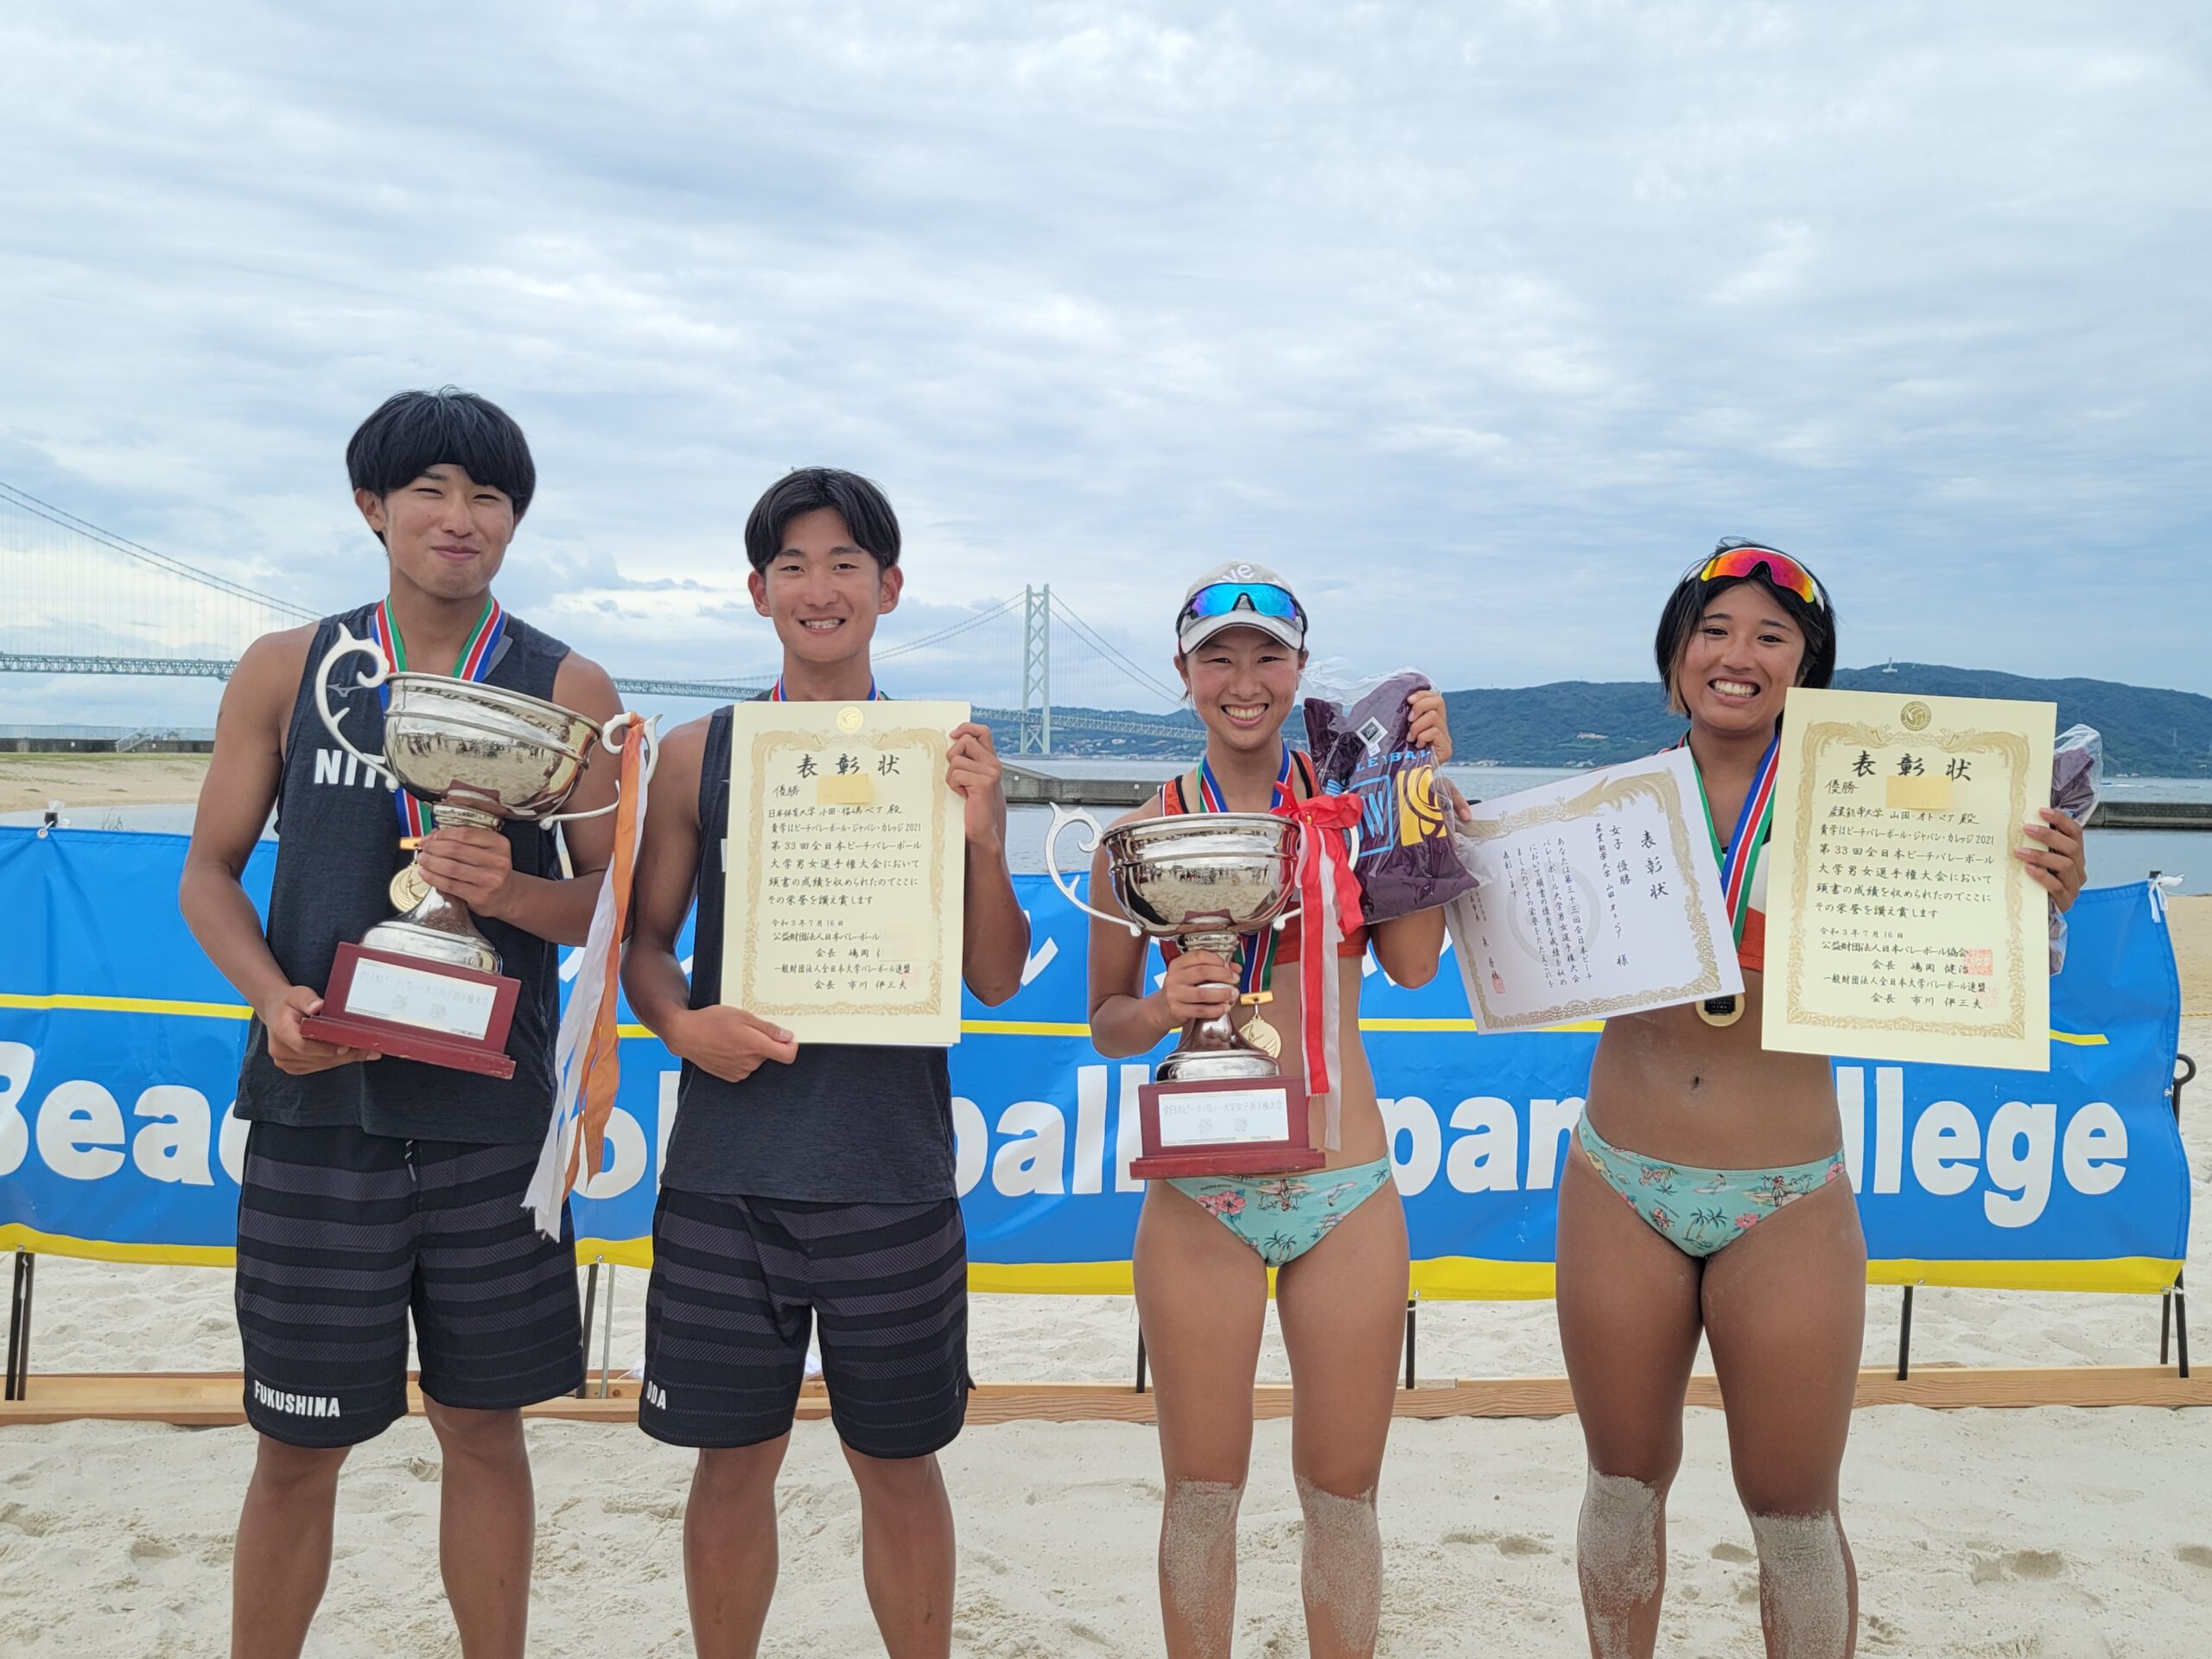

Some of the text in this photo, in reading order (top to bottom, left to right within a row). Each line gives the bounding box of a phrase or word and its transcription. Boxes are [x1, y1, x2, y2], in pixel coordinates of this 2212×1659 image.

[797, 753, 900, 779] 表彰状
[1851, 749, 1972, 781] 表彰状
[772, 784, 801, 798] 優勝
[1824, 779, 1859, 795] 優勝
[770, 858, 919, 870] 大学男女選手権大会において
[1641, 830, 1669, 899] 表彰状
[1817, 862, 1992, 884] 大学男女選手権大会において
[254, 1379, 340, 1417] FUKUSHIMA
